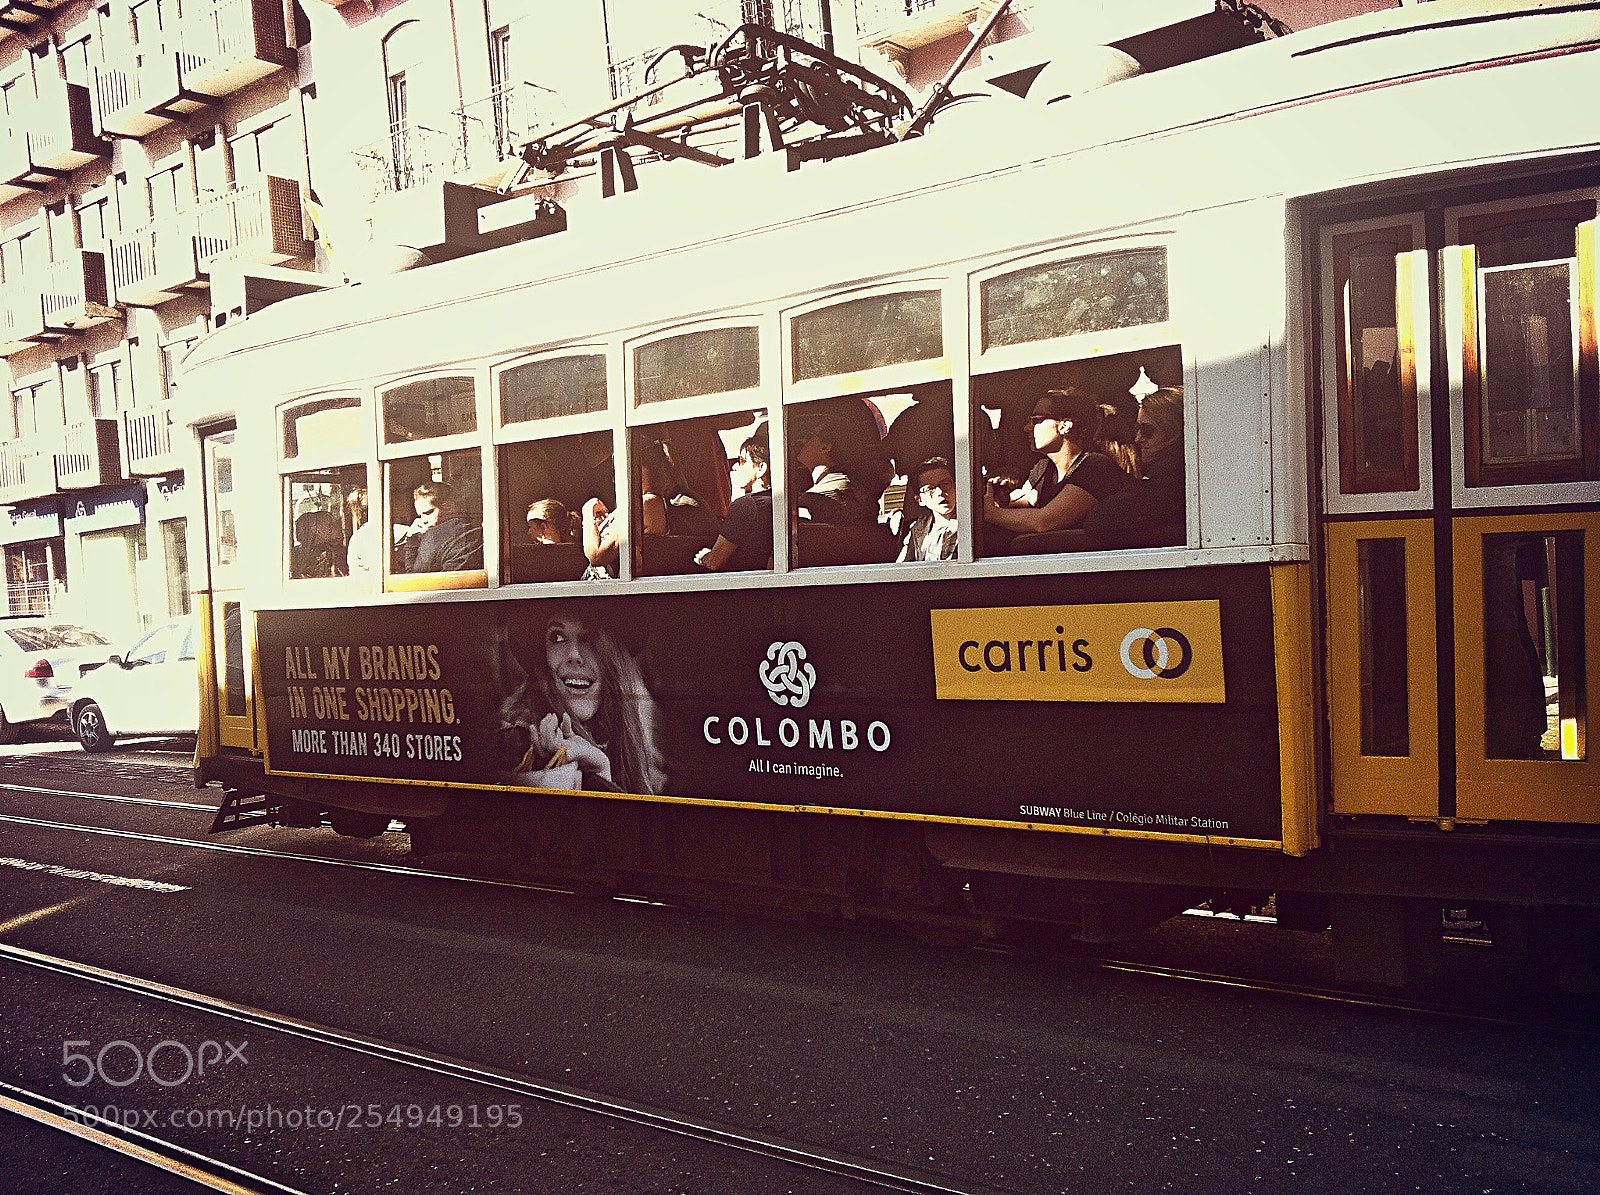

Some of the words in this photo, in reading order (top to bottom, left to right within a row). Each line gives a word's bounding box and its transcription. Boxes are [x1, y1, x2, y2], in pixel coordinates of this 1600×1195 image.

[285, 646, 317, 679] ALL
[322, 646, 351, 680] MY
[358, 645, 441, 680] BRANDS
[958, 625, 1093, 672] carris
[287, 686, 307, 719] IN
[312, 686, 350, 720] ONE
[355, 687, 461, 724] SHOPPING.
[292, 729, 327, 753] MORE
[332, 730, 368, 756] THAN
[373, 732, 400, 758] 340
[406, 734, 462, 761] STORES
[703, 716, 891, 752] COLOMBO
[749, 759, 764, 773] All
[766, 760, 770, 773] I
[772, 762, 792, 775] can
[793, 762, 844, 779] imagine.
[1019, 805, 1061, 818] SUBWAY
[1063, 808, 1085, 819] Blue
[1086, 809, 1107, 821] Line
[1109, 810, 1115, 822] /
[1155, 814, 1189, 826] Militar
[1190, 816, 1229, 829] Station
